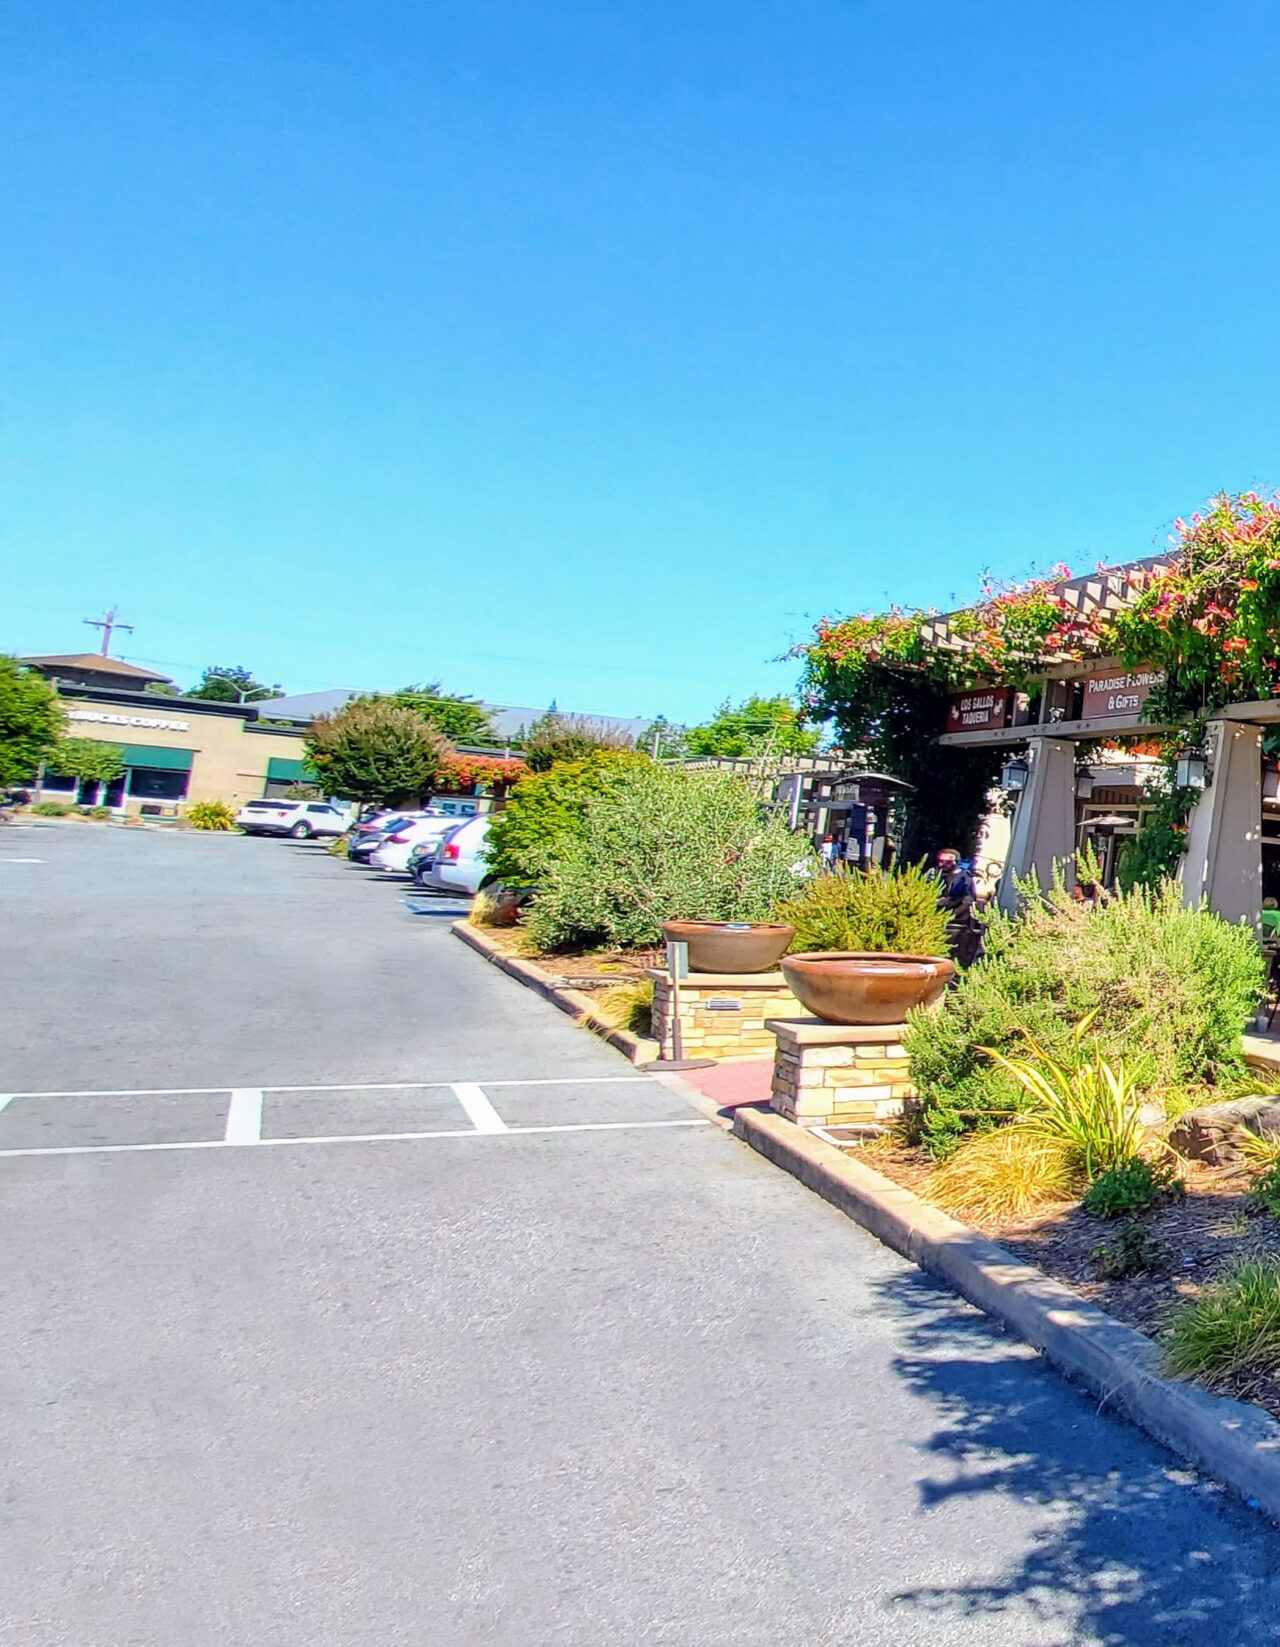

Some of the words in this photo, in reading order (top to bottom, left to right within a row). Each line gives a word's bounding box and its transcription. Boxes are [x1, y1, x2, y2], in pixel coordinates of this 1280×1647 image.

[1089, 677, 1125, 693] PARADISE
[960, 697, 971, 711] LOS
[972, 695, 994, 709] GALLOS
[1108, 695, 1114, 709] &
[1116, 695, 1139, 708] GIFTS
[130, 716, 190, 731] COFFEE
[962, 710, 988, 724] TAQUERIA
